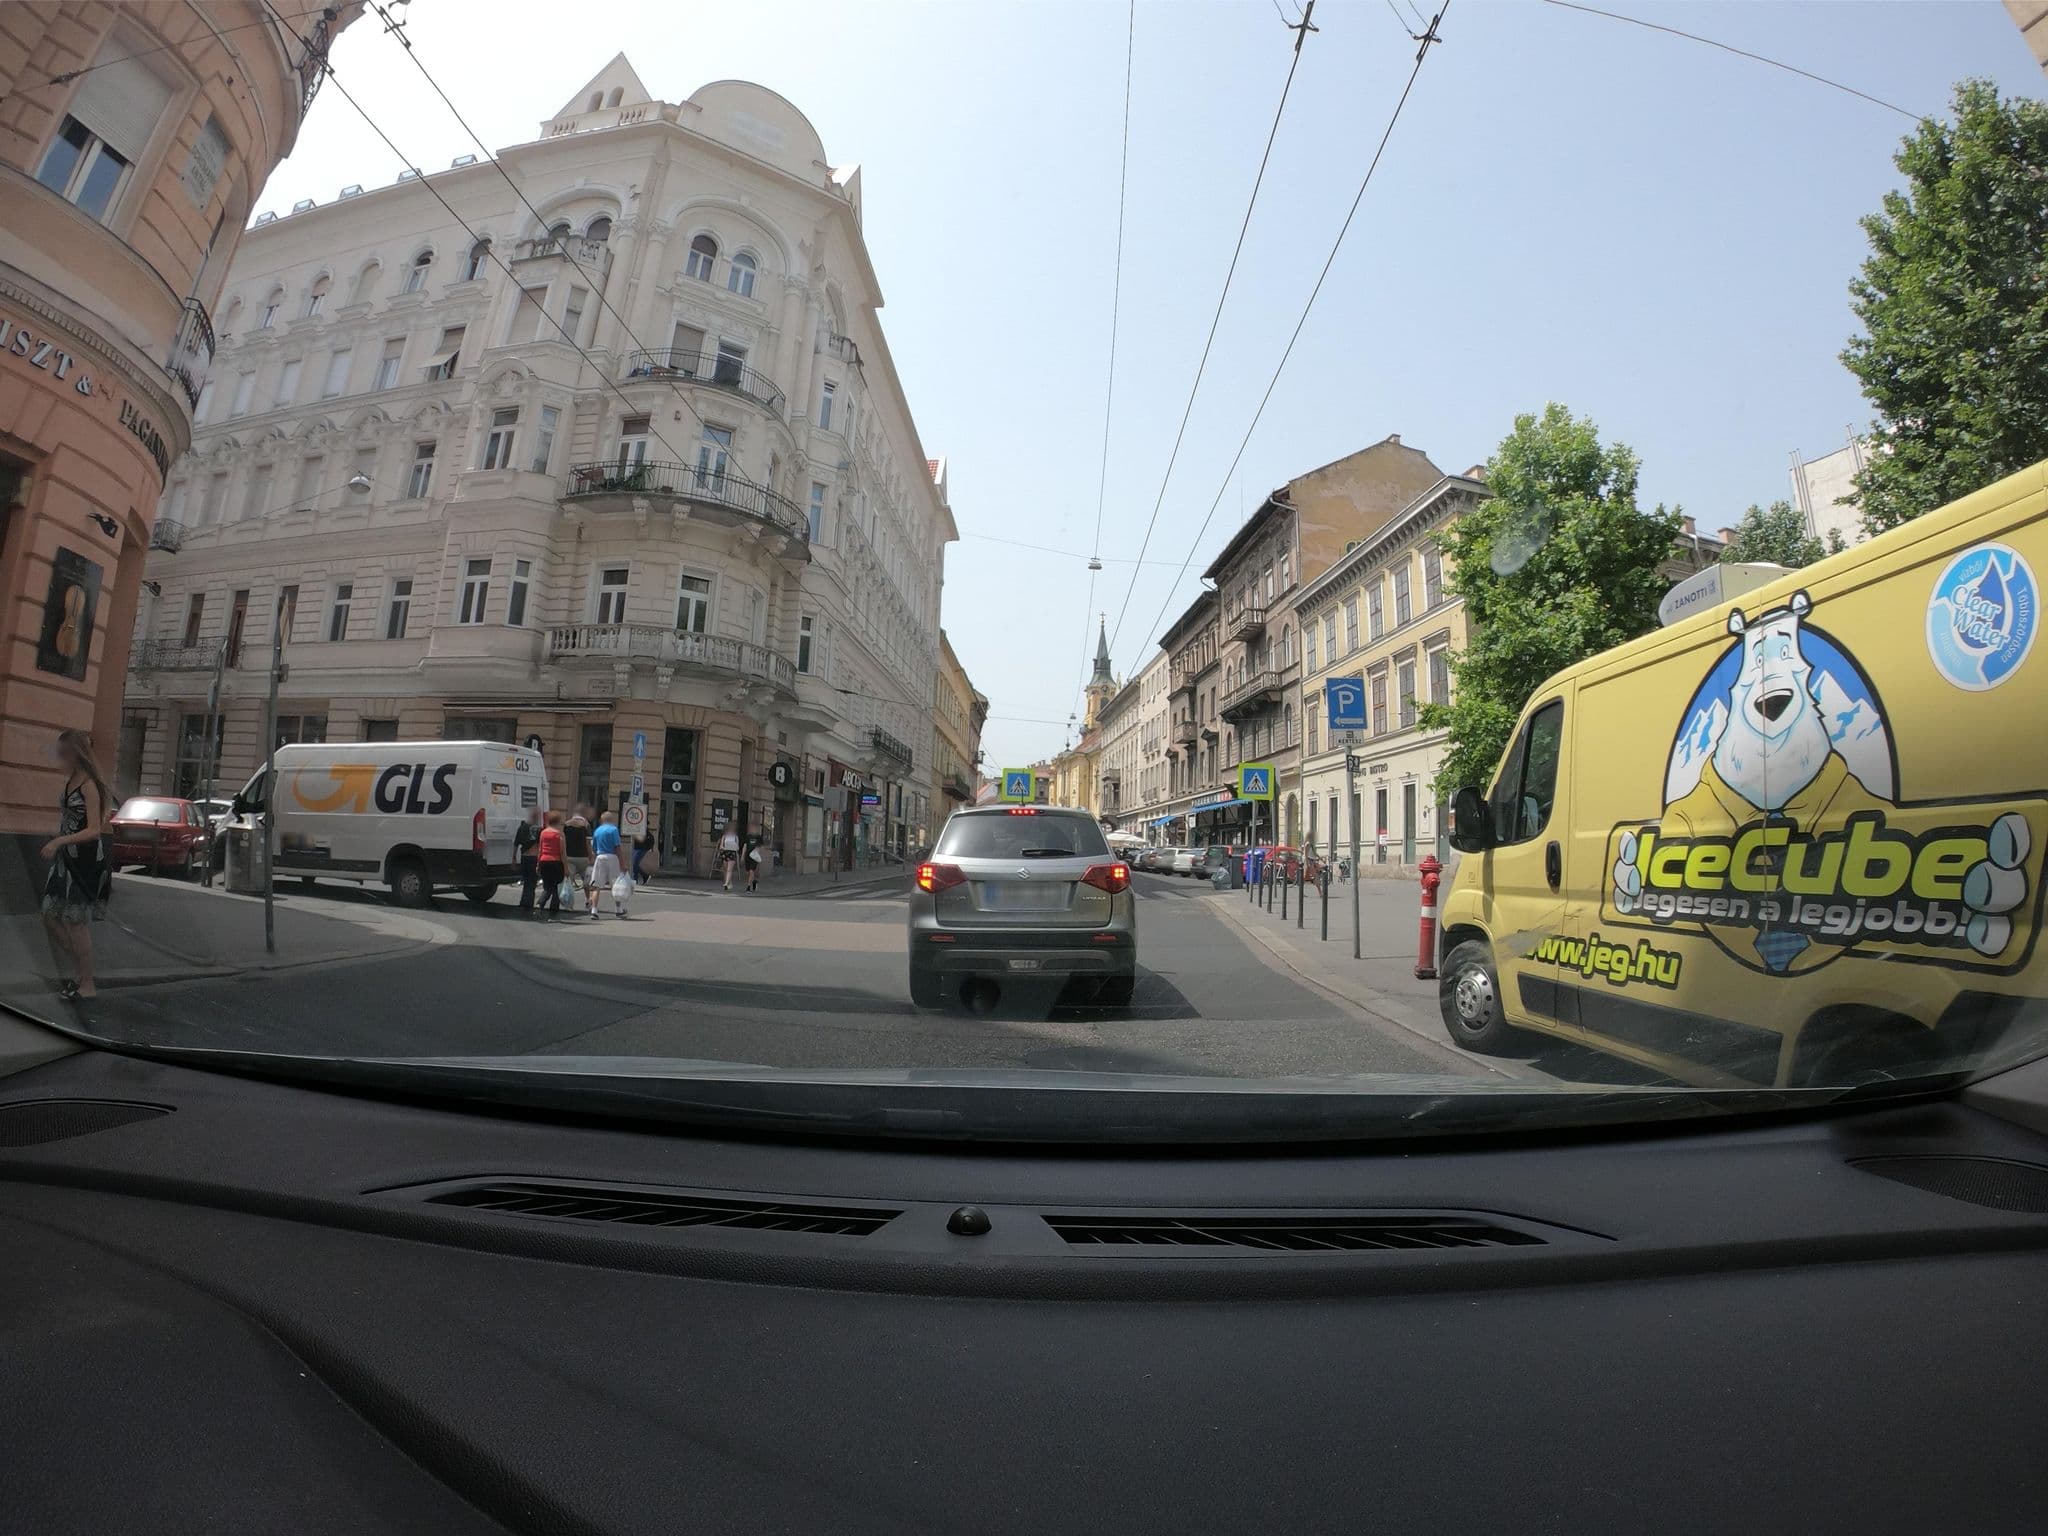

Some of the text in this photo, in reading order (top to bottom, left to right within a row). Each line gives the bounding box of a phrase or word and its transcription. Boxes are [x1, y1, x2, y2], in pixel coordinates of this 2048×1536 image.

[76, 376, 92, 396] &
[1675, 586, 1708, 610] ZANOTTI
[1951, 585, 2002, 620] Clear
[1953, 606, 2010, 649] Water
[1338, 690, 1354, 714] P
[516, 758, 529, 772] GLS
[775, 766, 786, 783] B
[375, 763, 457, 814] GLS
[634, 780, 641, 795] P
[629, 811, 640, 820] 30
[1637, 821, 1988, 900] IceCube
[1759, 899, 1781, 922] a
[1788, 895, 1972, 937] legjobb!
[1527, 937, 1680, 984] ww.jeg.hu
